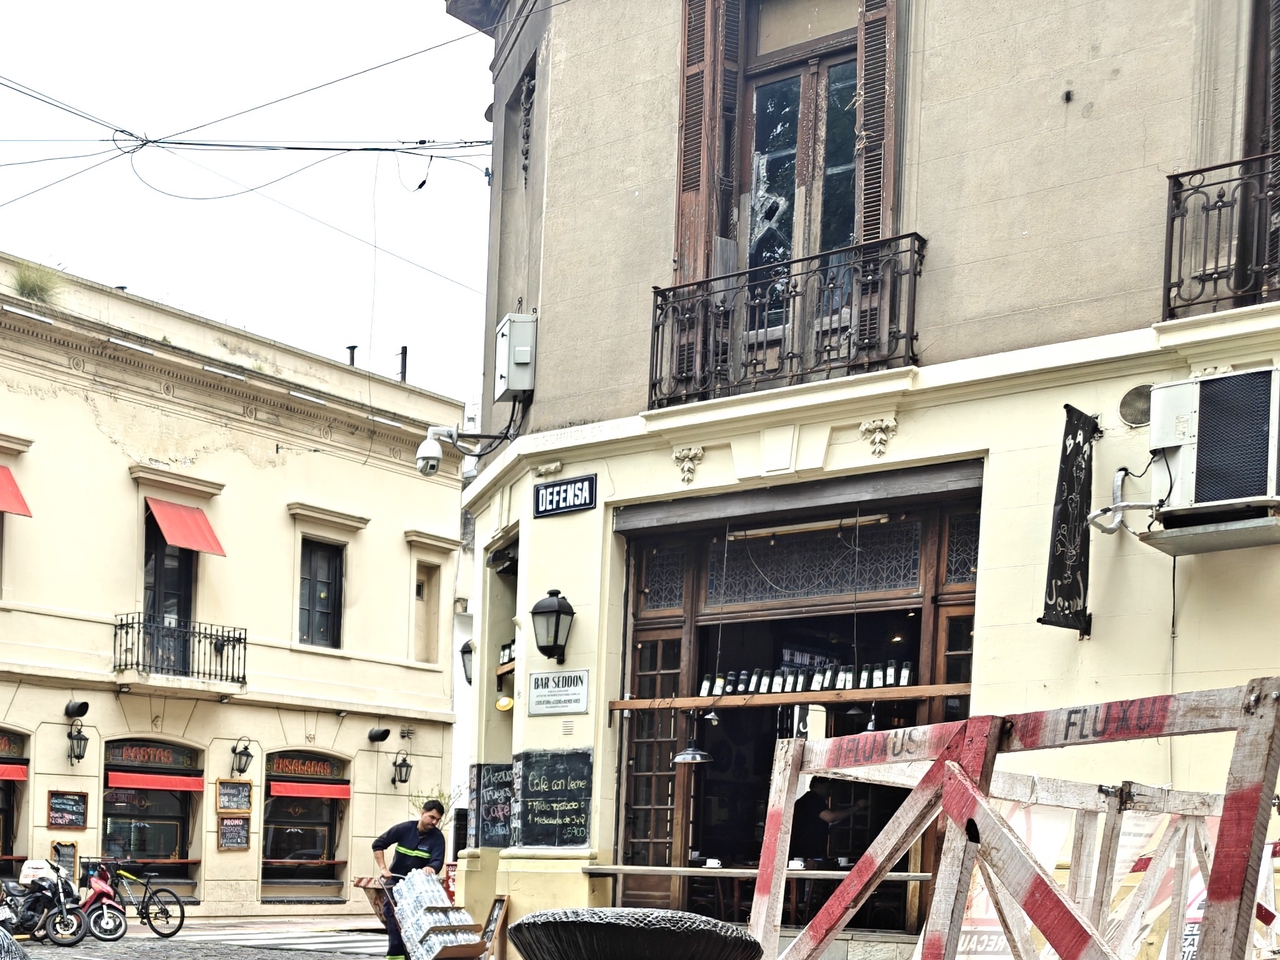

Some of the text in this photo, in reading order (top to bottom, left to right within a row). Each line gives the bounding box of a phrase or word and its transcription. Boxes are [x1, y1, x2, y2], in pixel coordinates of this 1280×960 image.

[538, 480, 590, 512] DEFENSA
[533, 674, 584, 690] BAR SEDDON
[122, 744, 174, 764] PASTAS
[273, 755, 332, 776] ENSALADAS
[482, 766, 513, 786] Pizzas
[552, 779, 565, 791] con
[482, 786, 512, 803] Tragos
[223, 818, 243, 826] PROMO
